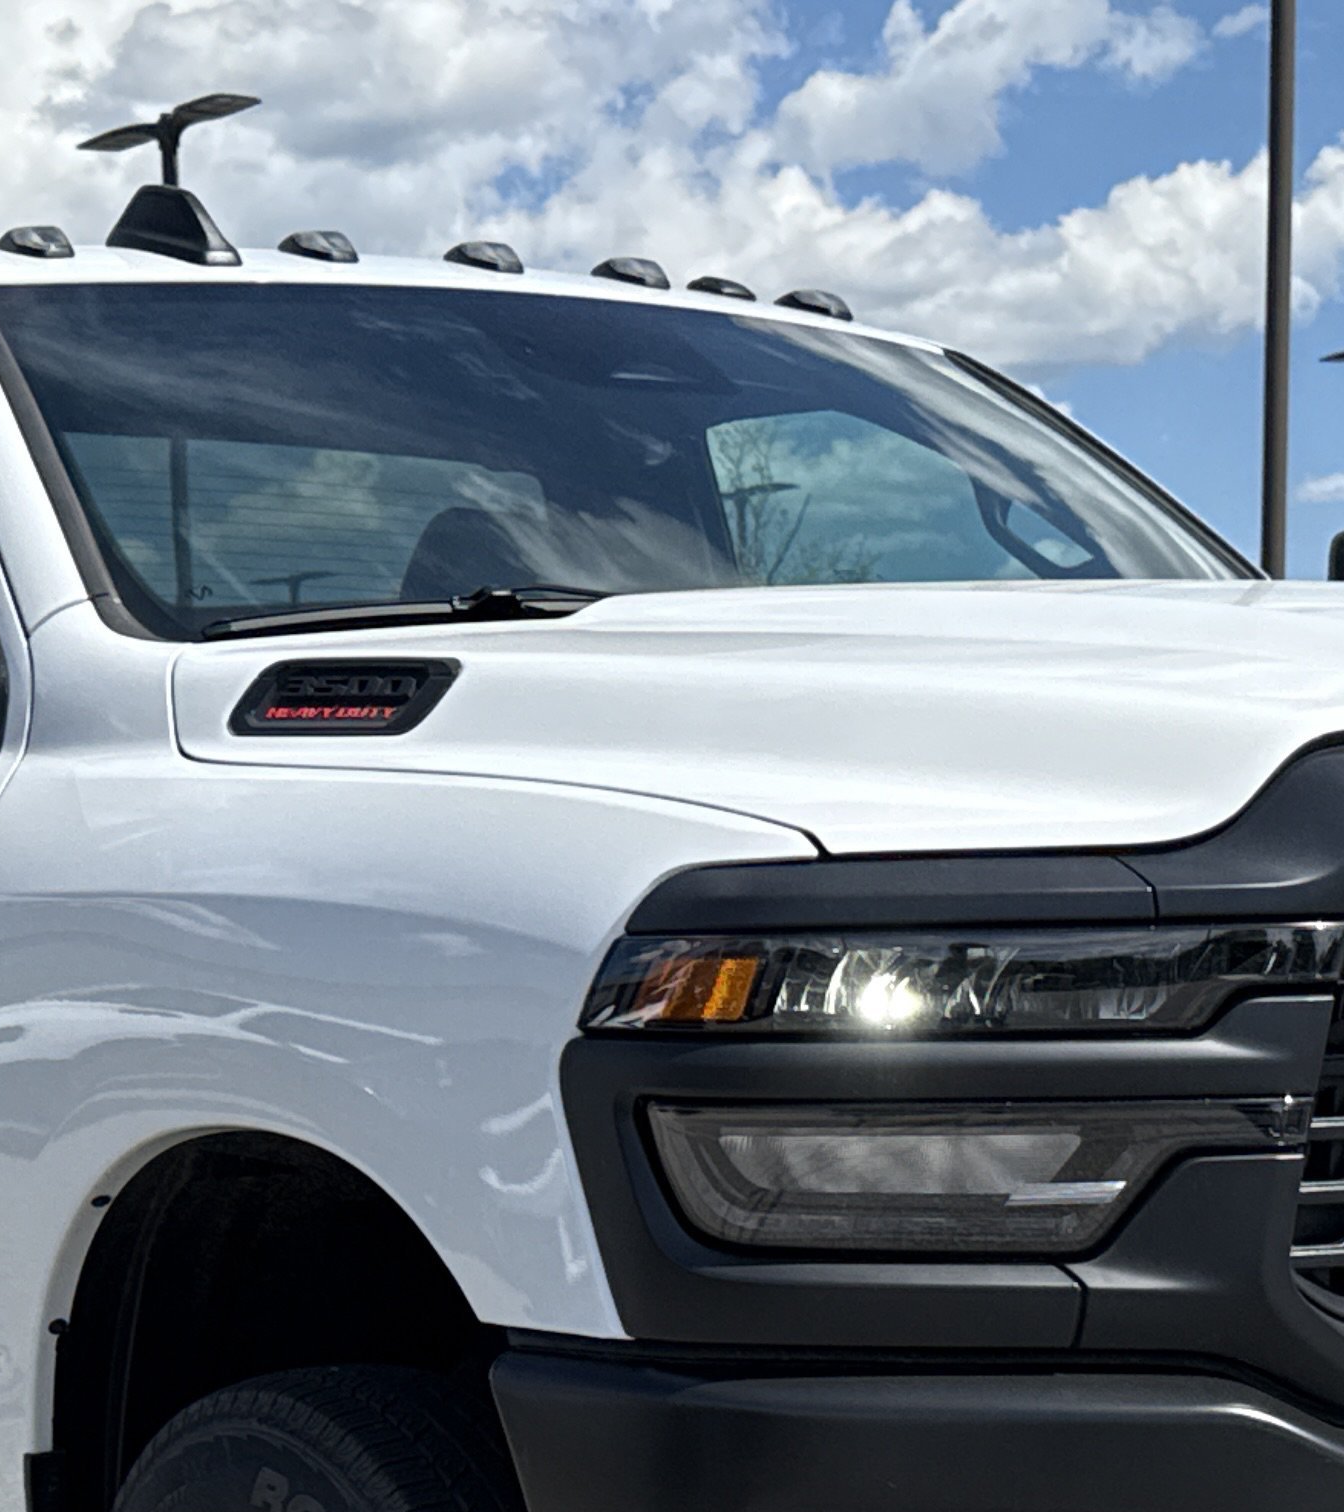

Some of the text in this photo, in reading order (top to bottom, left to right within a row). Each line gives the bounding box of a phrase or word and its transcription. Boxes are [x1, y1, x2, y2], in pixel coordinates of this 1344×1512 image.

[278, 674, 418, 698] 3500
[265, 705, 398, 719] HEAVY DUTY
